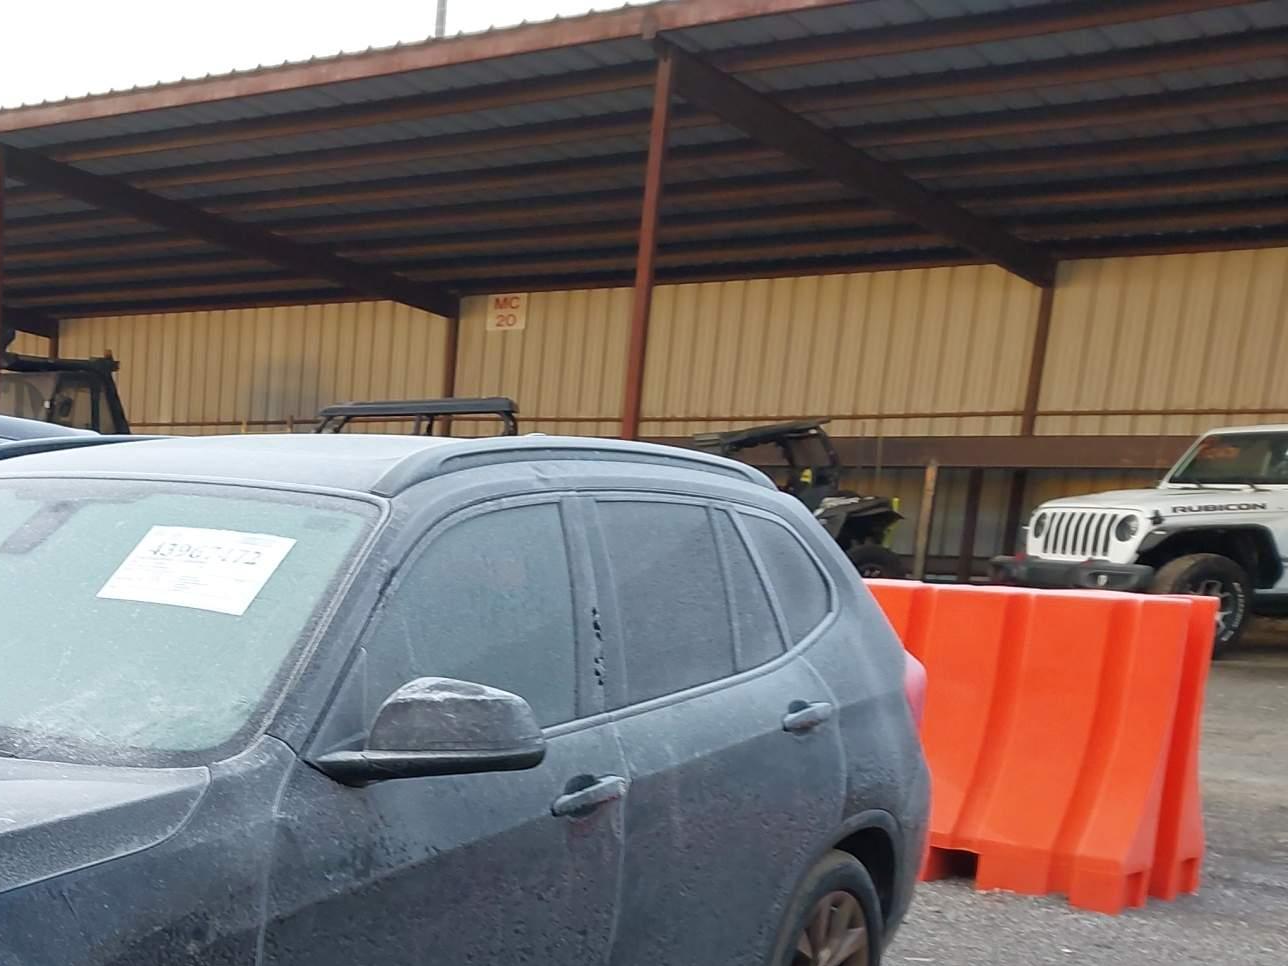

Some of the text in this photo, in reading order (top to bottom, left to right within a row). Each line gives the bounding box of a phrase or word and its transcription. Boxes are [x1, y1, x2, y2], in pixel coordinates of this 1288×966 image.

[495, 296, 520, 309] MC
[495, 314, 517, 327] 20
[1172, 503, 1267, 513] RUBICON
